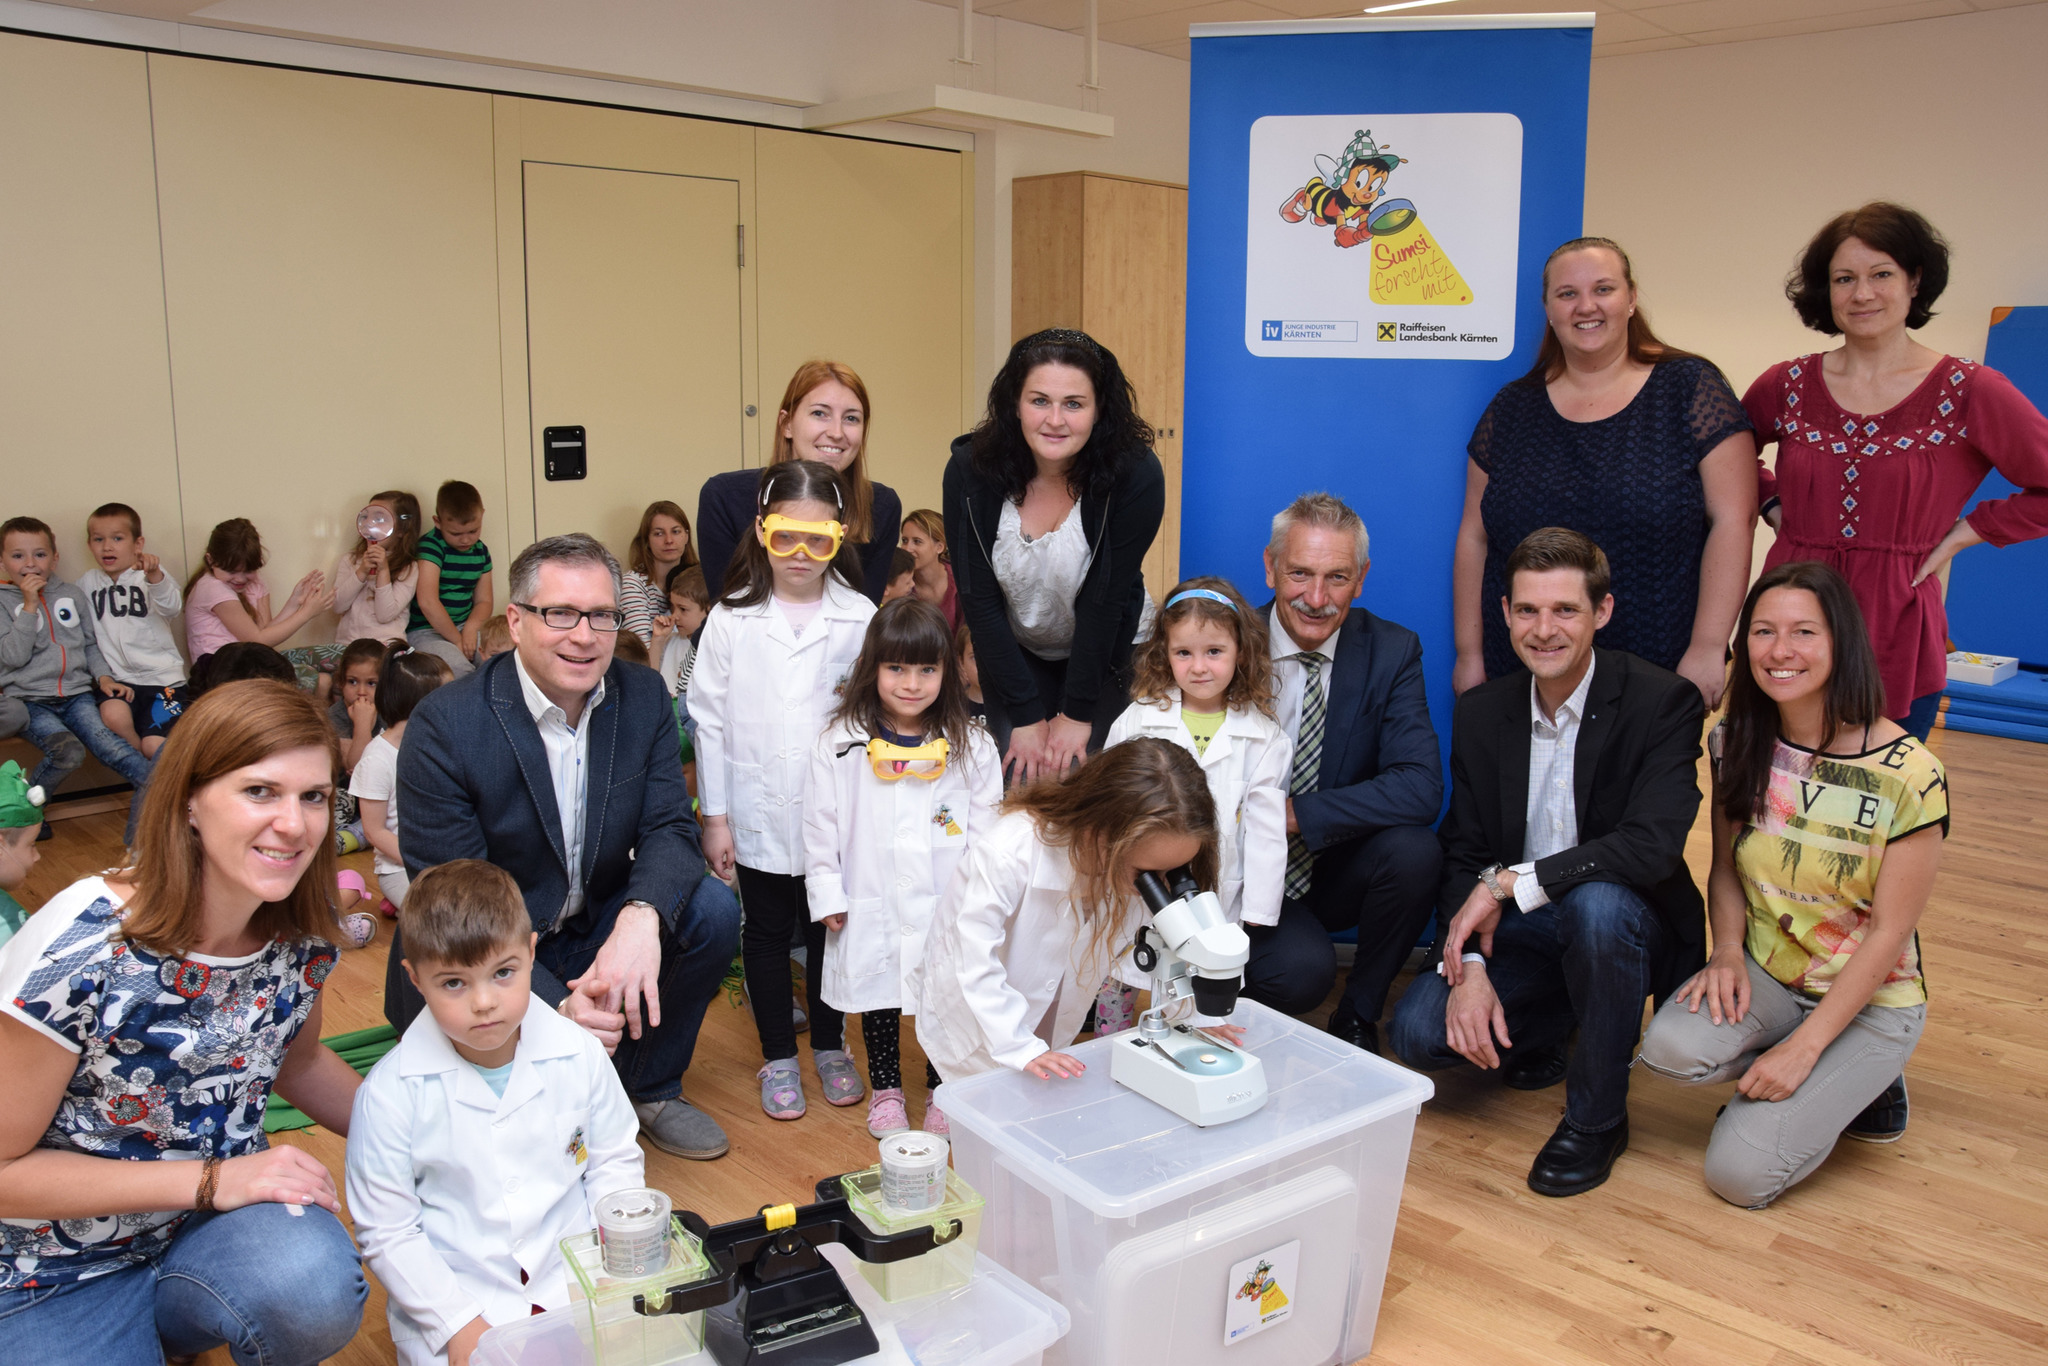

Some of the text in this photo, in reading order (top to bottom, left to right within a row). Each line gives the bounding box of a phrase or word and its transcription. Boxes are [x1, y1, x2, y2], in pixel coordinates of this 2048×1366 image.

[1374, 233, 1431, 270] Sumsi
[1375, 249, 1444, 301] forscht
[1265, 322, 1279, 338] iv
[1399, 322, 1446, 332] Raiffeisen
[1399, 332, 1498, 343] Landesbank Kärnten
[1779, 887, 1820, 903] HEAR
